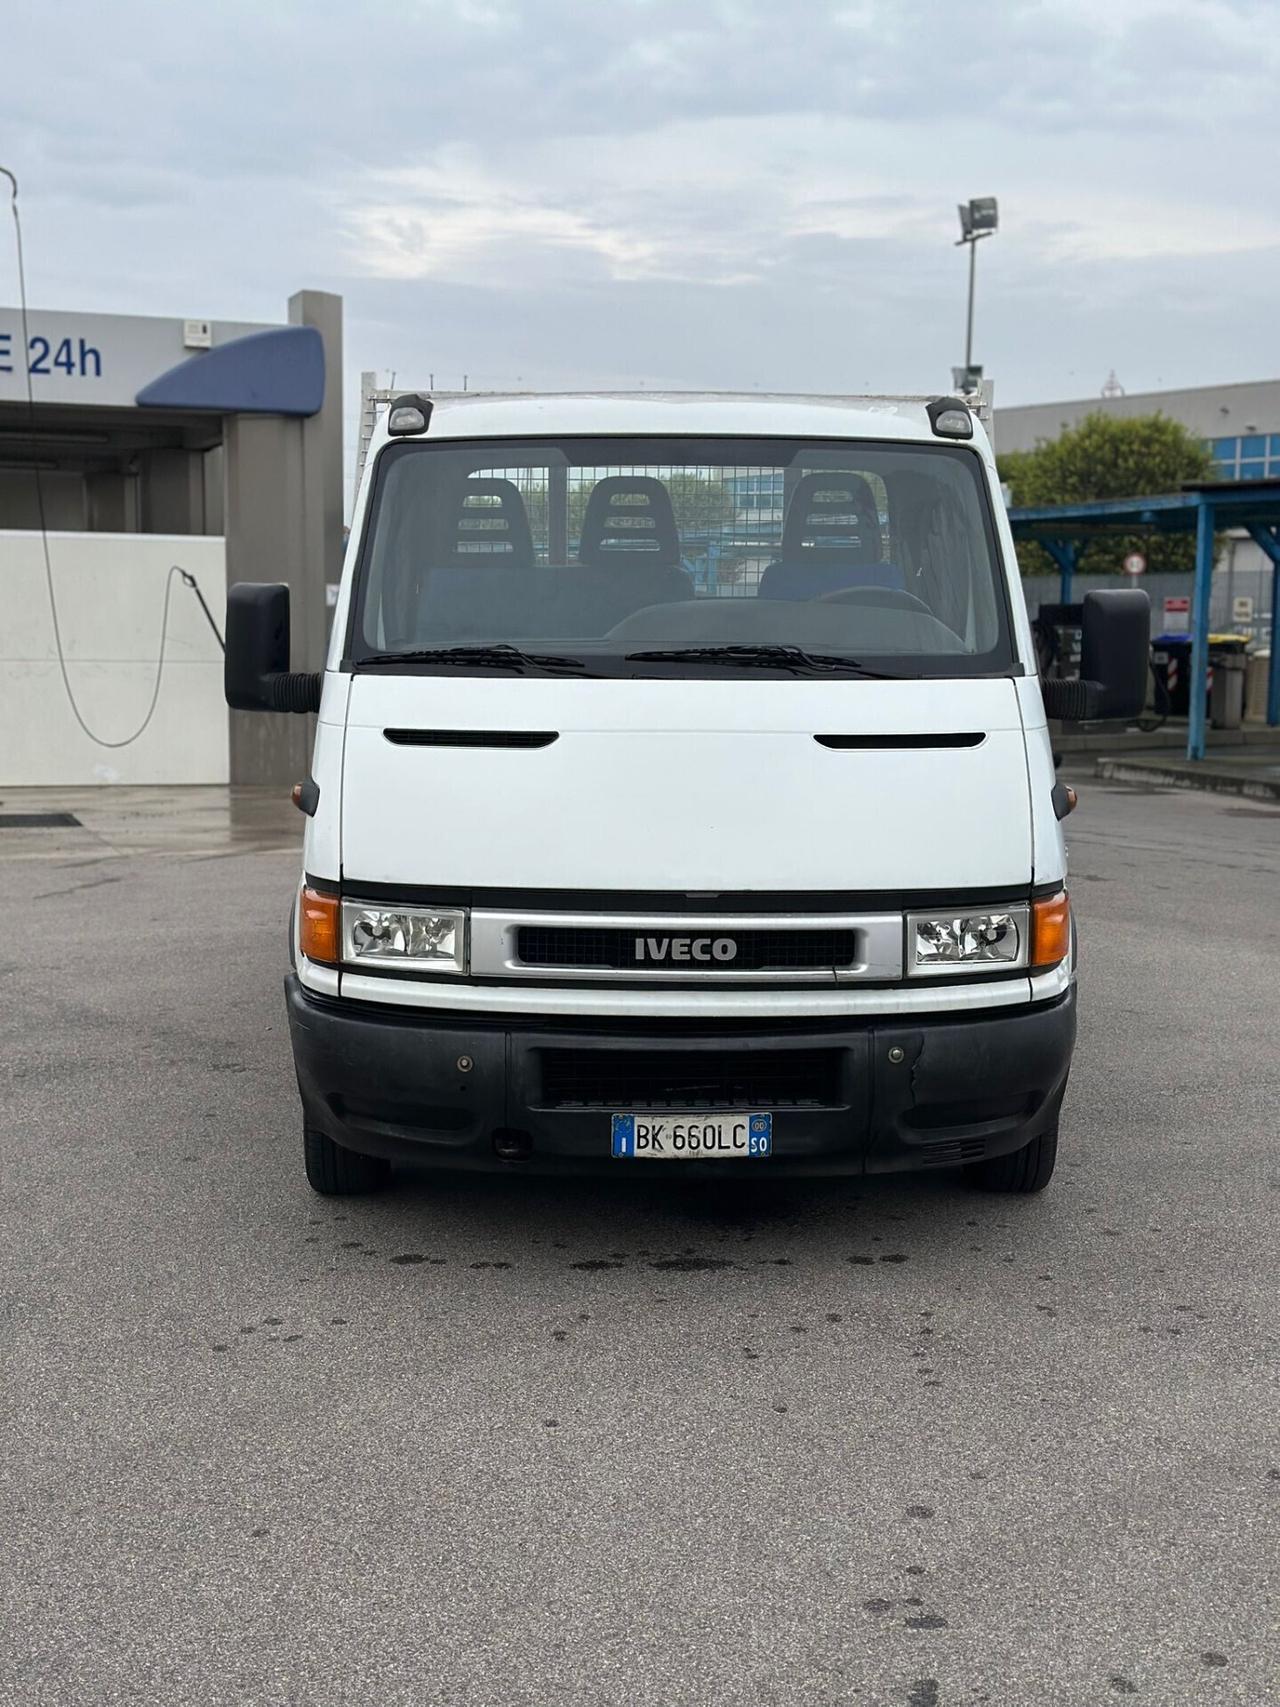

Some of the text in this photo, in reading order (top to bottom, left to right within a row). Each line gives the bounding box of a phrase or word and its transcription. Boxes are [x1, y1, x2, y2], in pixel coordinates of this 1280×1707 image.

[28, 335, 102, 377] 24h
[635, 938, 738, 961] IVECO
[636, 1124, 665, 1150] BK
[672, 1124, 746, 1150] 660LC
[750, 1137, 767, 1153] SO
